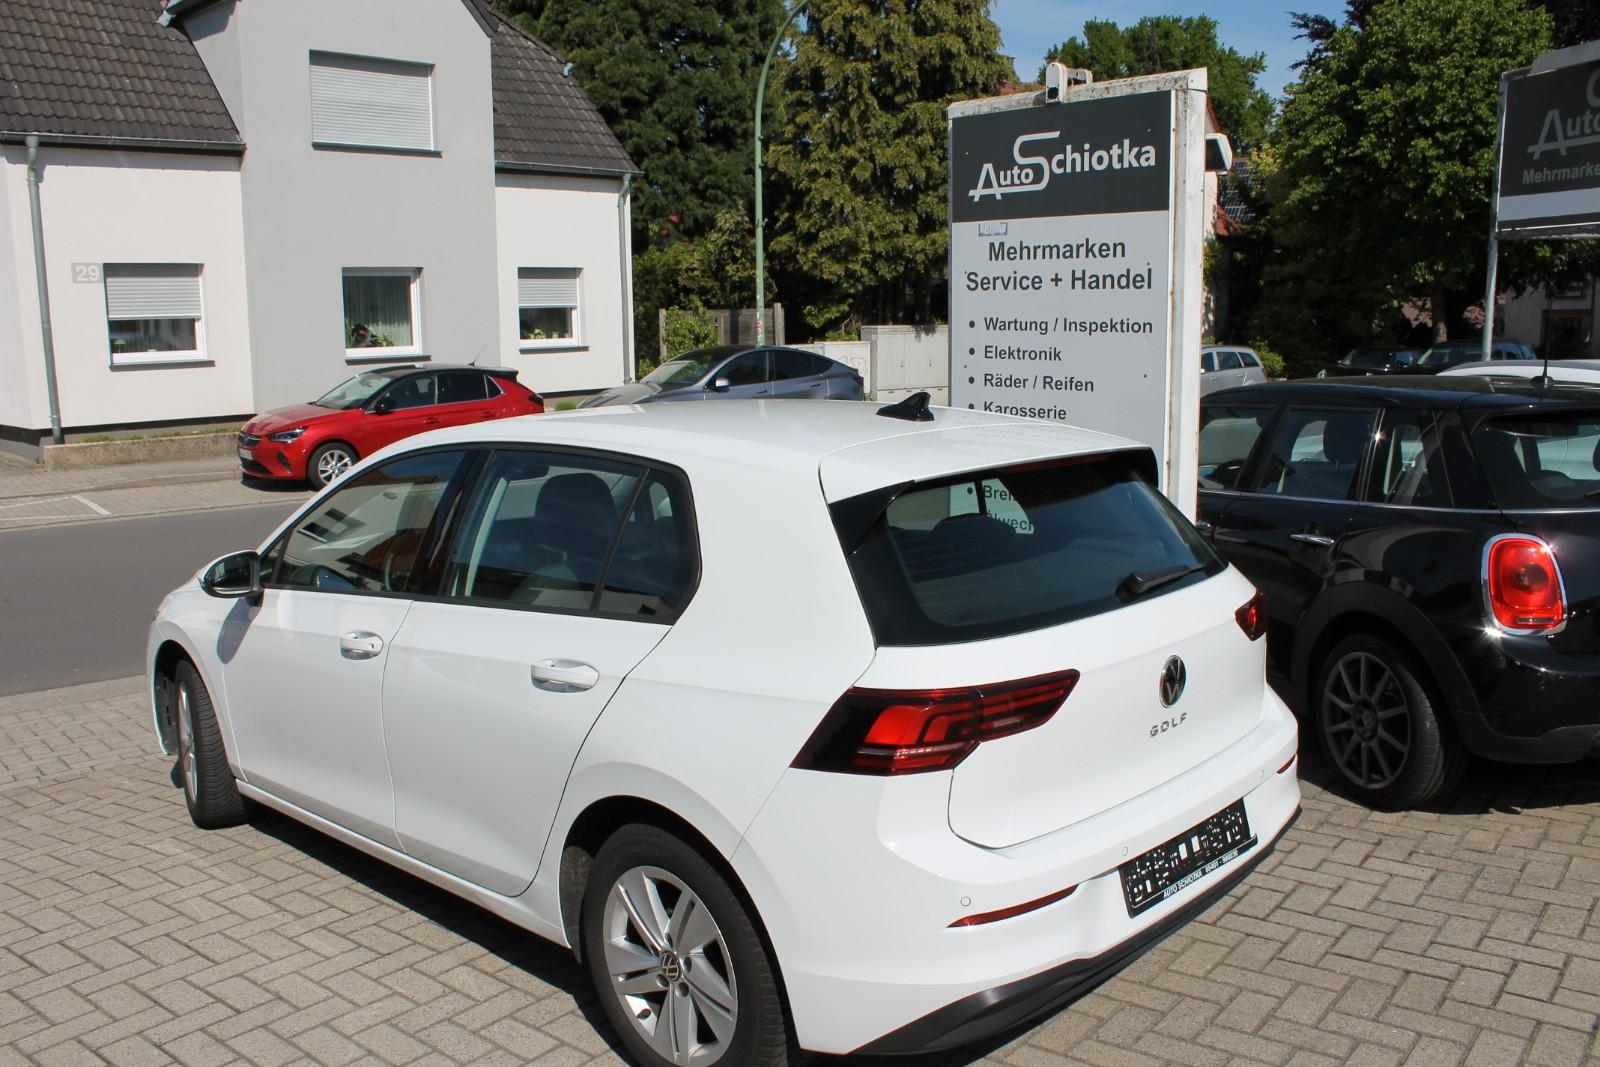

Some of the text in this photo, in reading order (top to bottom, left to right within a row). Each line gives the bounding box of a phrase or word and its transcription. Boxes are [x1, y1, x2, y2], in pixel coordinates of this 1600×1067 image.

[968, 131, 1156, 202] Auto Schiotka
[988, 238, 1126, 262] Mehrmarken
[75, 265, 100, 282] 29
[965, 267, 1152, 292] Service + Handel
[984, 317, 1049, 336] Wartung
[1063, 317, 1153, 336] Inspektion
[984, 345, 1062, 362] Elektronik
[983, 373, 1029, 389] Räder
[1043, 375, 1095, 393] Reifen
[983, 400, 1067, 420] Karosserie
[1149, 711, 1188, 738] GOLF
